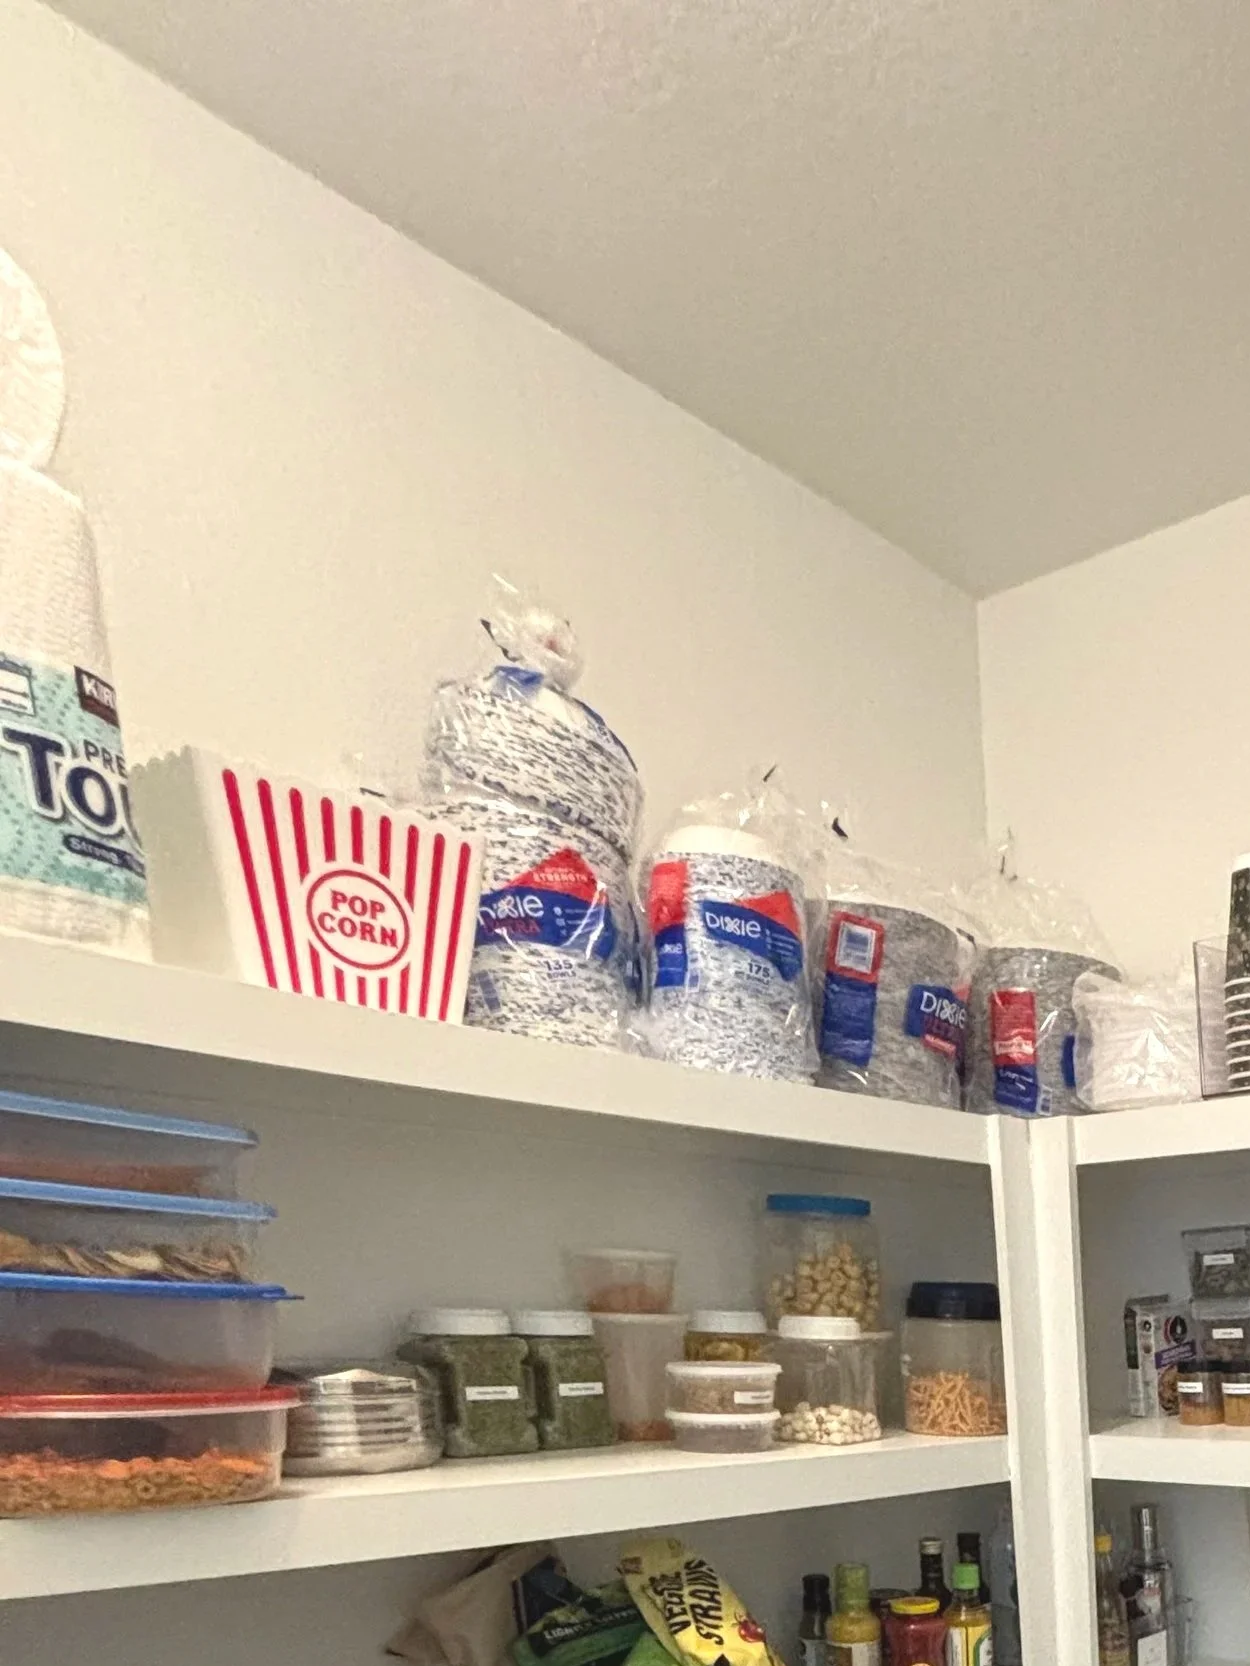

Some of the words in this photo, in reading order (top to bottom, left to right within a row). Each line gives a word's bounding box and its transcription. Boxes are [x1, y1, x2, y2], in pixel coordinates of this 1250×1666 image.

[330, 888, 386, 921] POP
[317, 911, 398, 950] CORN
[543, 957, 573, 972] 135
[747, 961, 770, 978] 175
[684, 1558, 725, 1646] STRAWS
